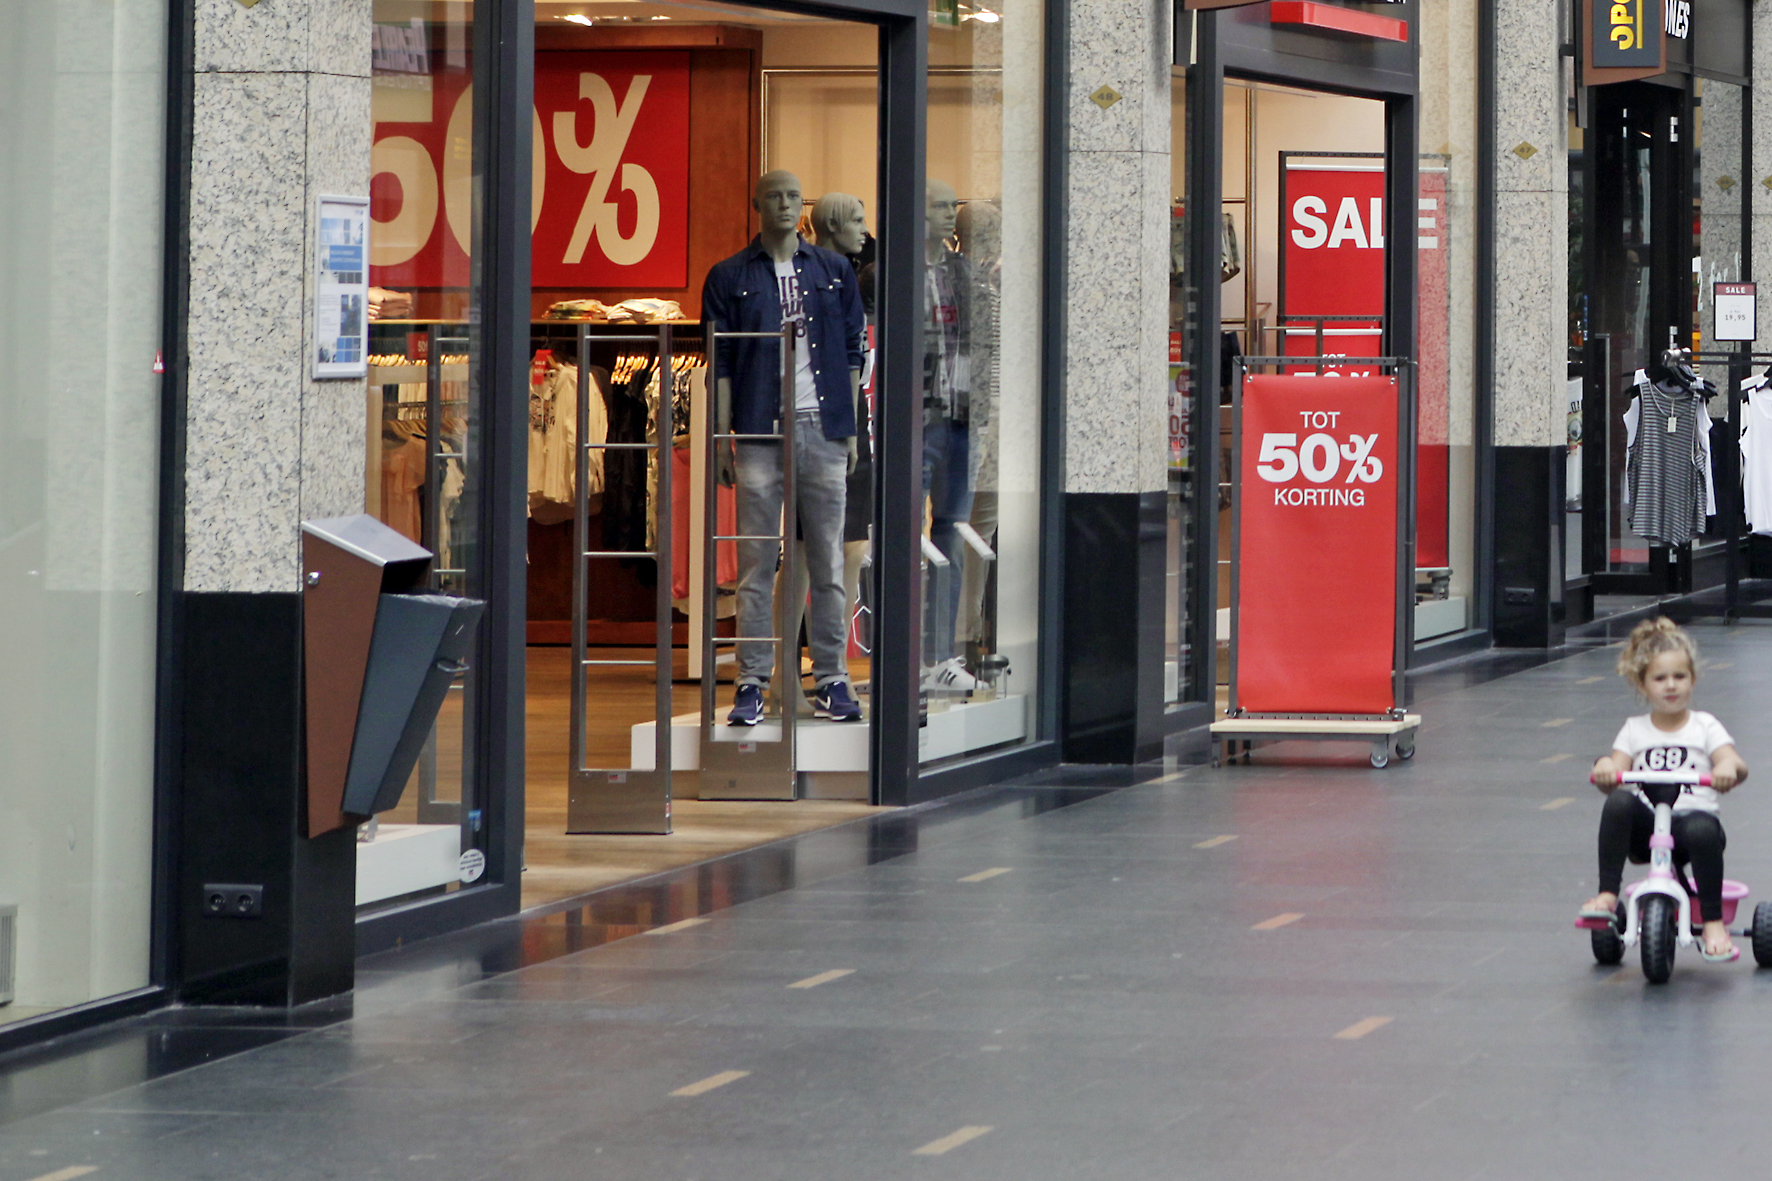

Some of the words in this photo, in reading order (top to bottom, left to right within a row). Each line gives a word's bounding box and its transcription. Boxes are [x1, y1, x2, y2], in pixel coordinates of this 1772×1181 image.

[1291, 195, 1438, 249] SALE
[1725, 286, 1746, 294] SALE
[1300, 411, 1340, 428] TOT
[1257, 433, 1383, 484] 50%
[1274, 488, 1365, 506] KORTING
